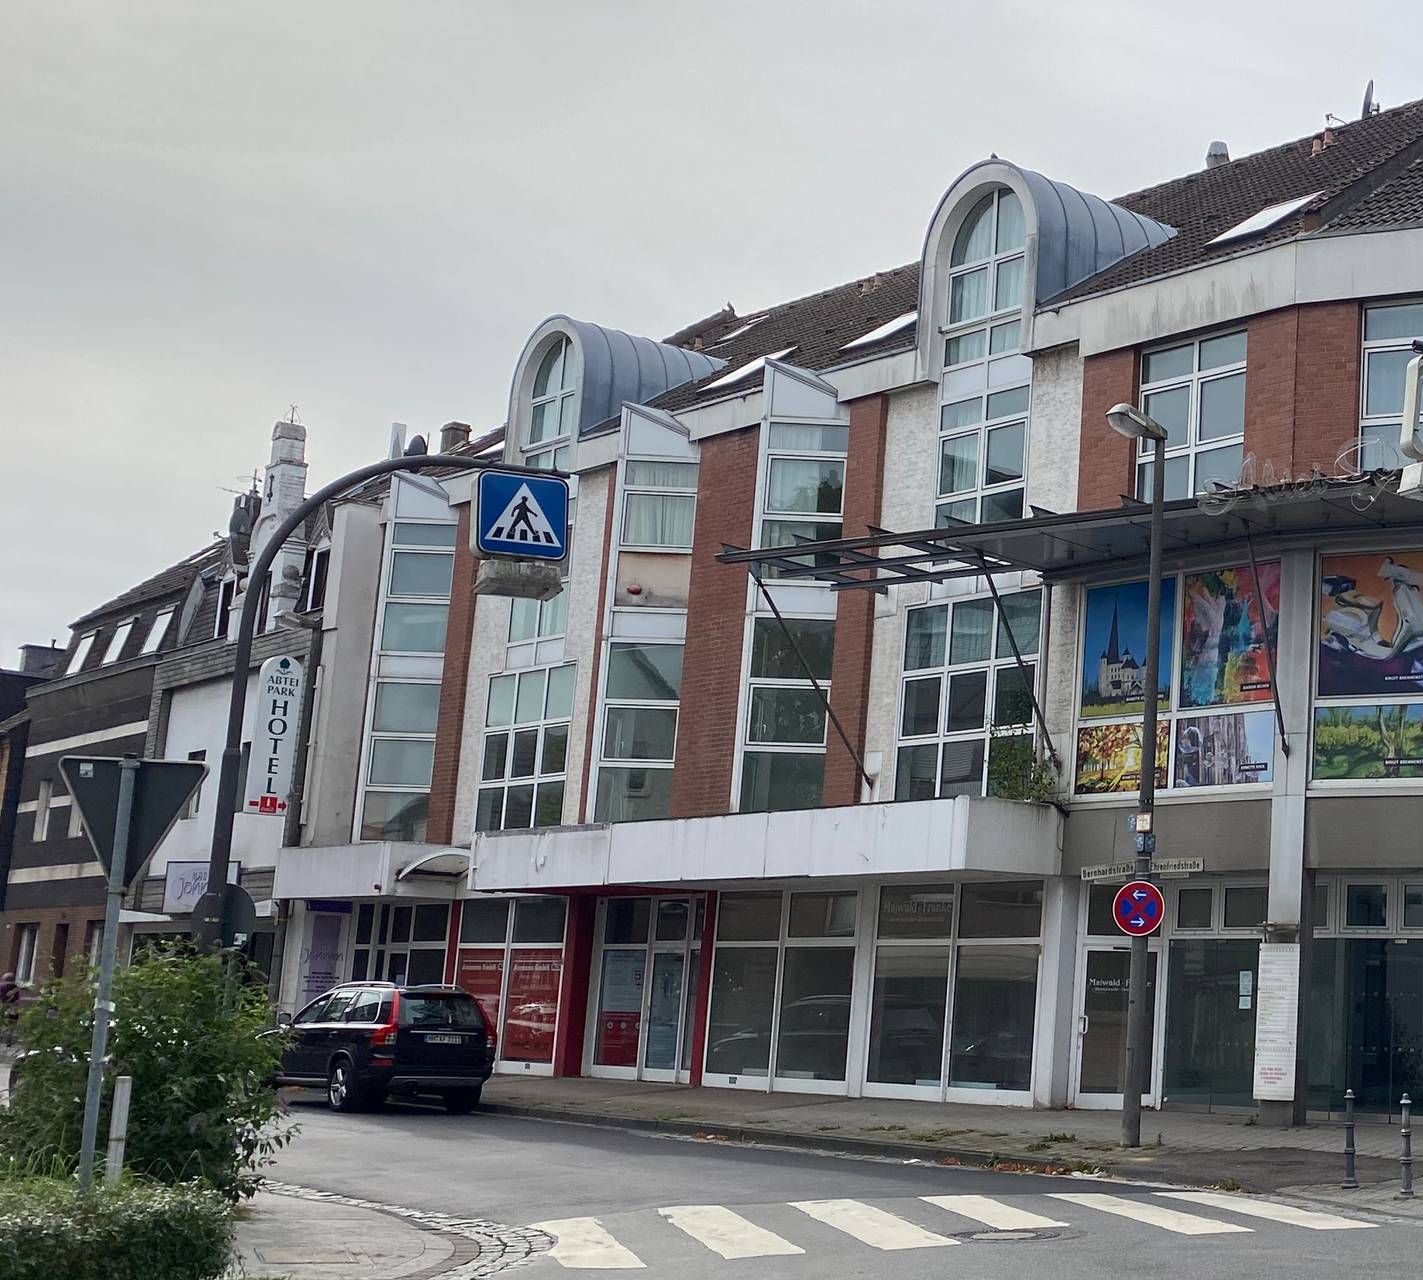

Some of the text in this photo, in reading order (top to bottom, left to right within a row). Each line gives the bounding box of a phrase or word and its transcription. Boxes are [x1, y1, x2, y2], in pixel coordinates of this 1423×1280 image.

[267, 675, 299, 687] ABTEI
[267, 685, 295, 697] PARK
[265, 699, 288, 795] HOTEL
[1082, 864, 1135, 879] Bernhardstraße
[1089, 977, 1121, 987] Maiwald
